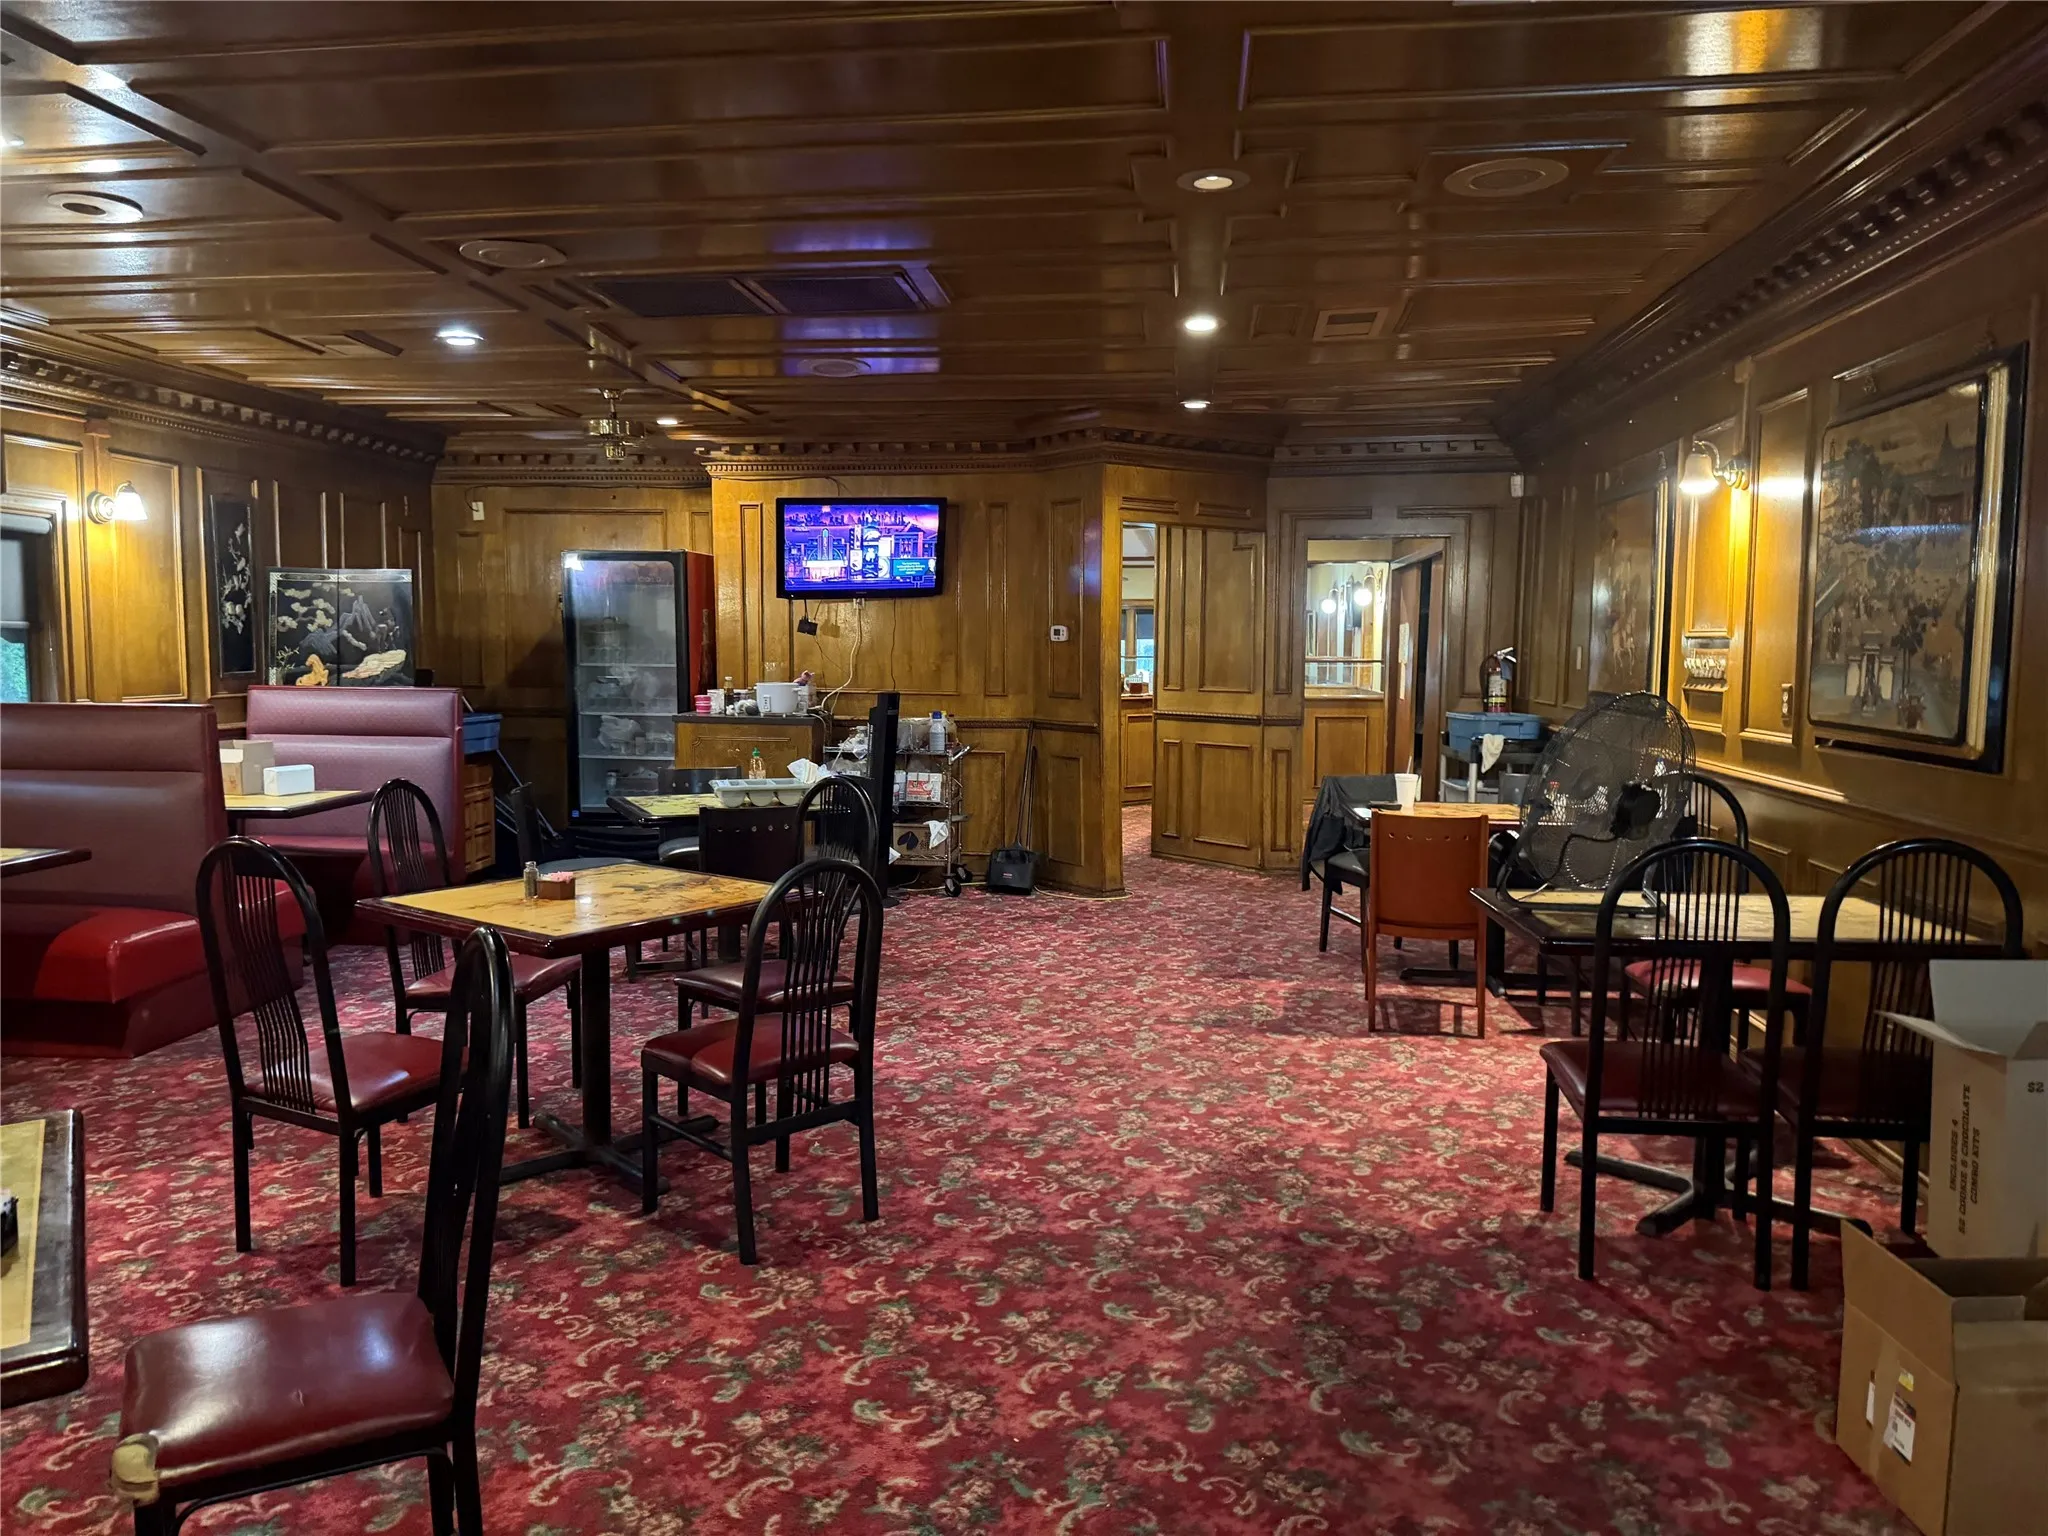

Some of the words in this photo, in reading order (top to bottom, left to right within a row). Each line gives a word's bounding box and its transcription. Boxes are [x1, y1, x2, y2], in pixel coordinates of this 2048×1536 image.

[1961, 1084, 1970, 1156] CHOCOLATE
[1949, 1129, 1958, 1191] INCLUDES
[1972, 1127, 1980, 1158] KITS
[1959, 1171, 1968, 1215] COOKIE
[1970, 1162, 1979, 1204] COMBO
